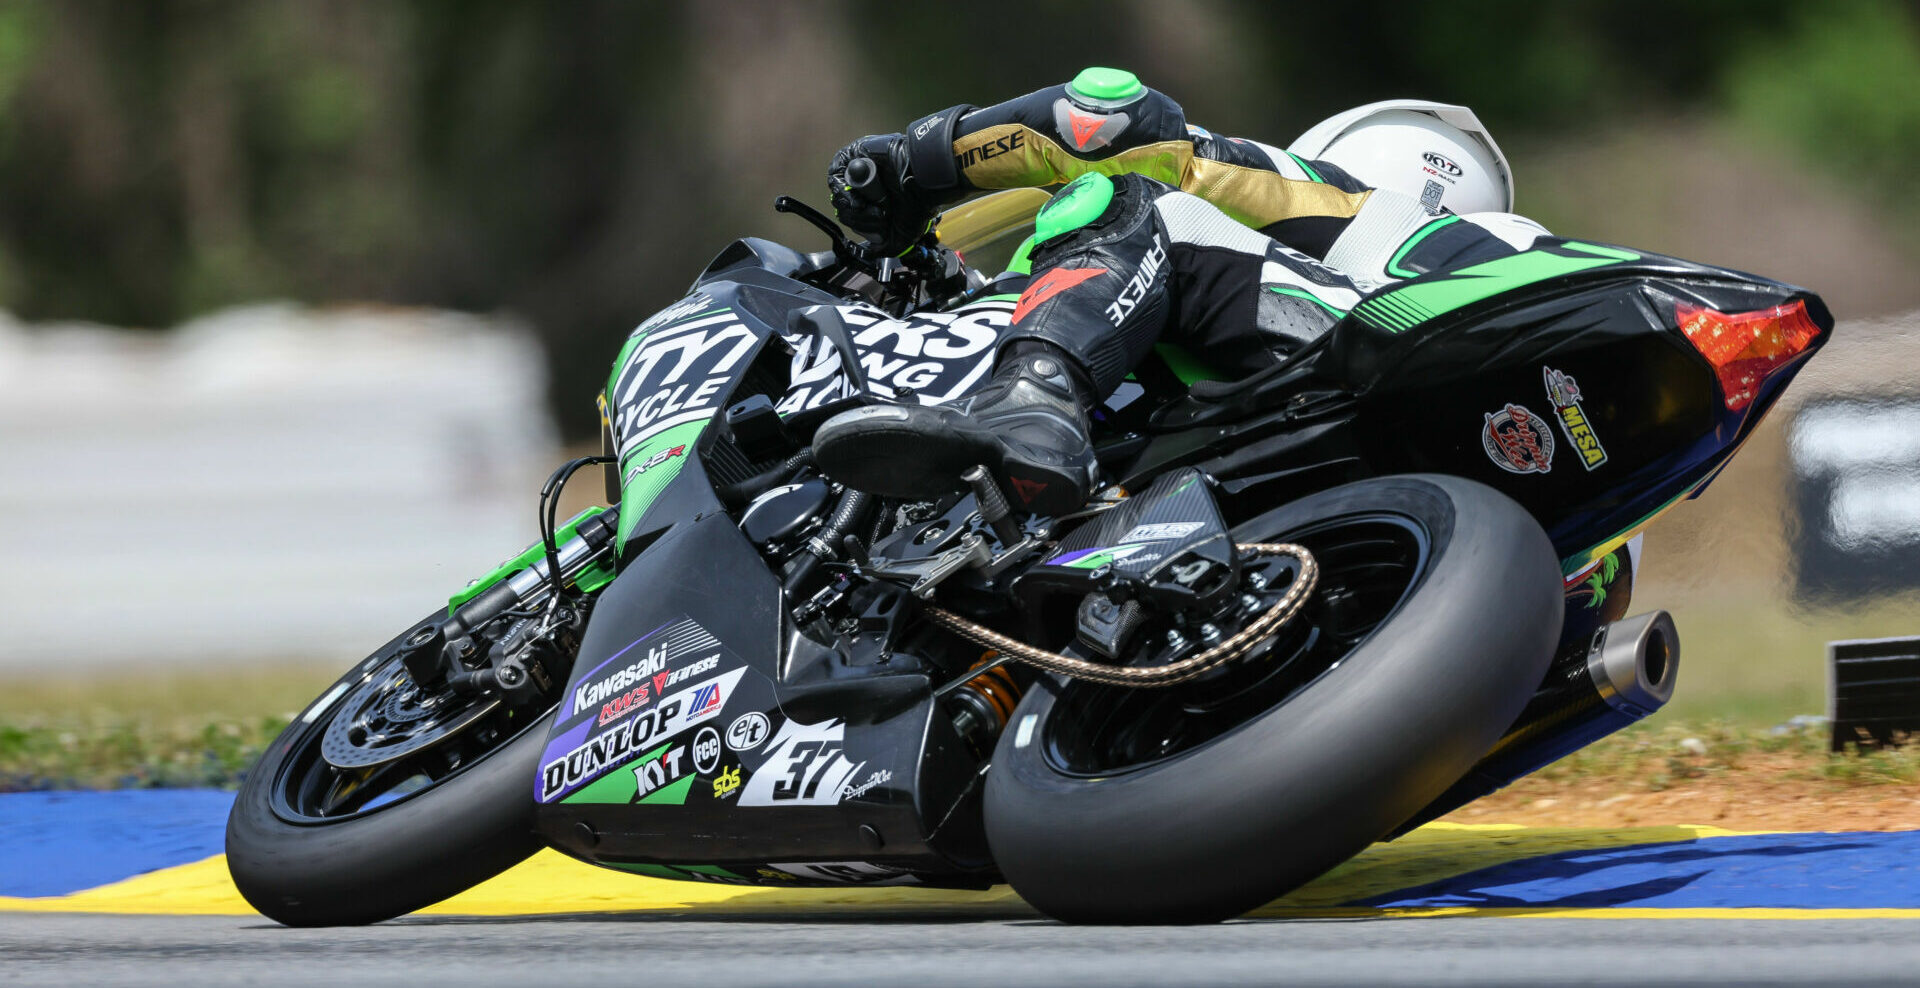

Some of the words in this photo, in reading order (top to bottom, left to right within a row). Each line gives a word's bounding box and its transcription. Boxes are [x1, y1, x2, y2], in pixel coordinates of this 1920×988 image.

[955, 129, 1025, 170] INESE
[1425, 152, 1460, 174] KYT
[1563, 406, 1603, 465] MESA
[573, 642, 668, 716] Kawasaki
[664, 653, 721, 688] DAINESE
[599, 682, 651, 721] KWS
[686, 704, 722, 722] MOTOAMERICA
[544, 699, 683, 799] DUNLOP
[696, 738, 718, 764] FCC
[633, 745, 686, 797] KYT
[713, 765, 740, 798] sbs
[773, 740, 844, 801] 37
